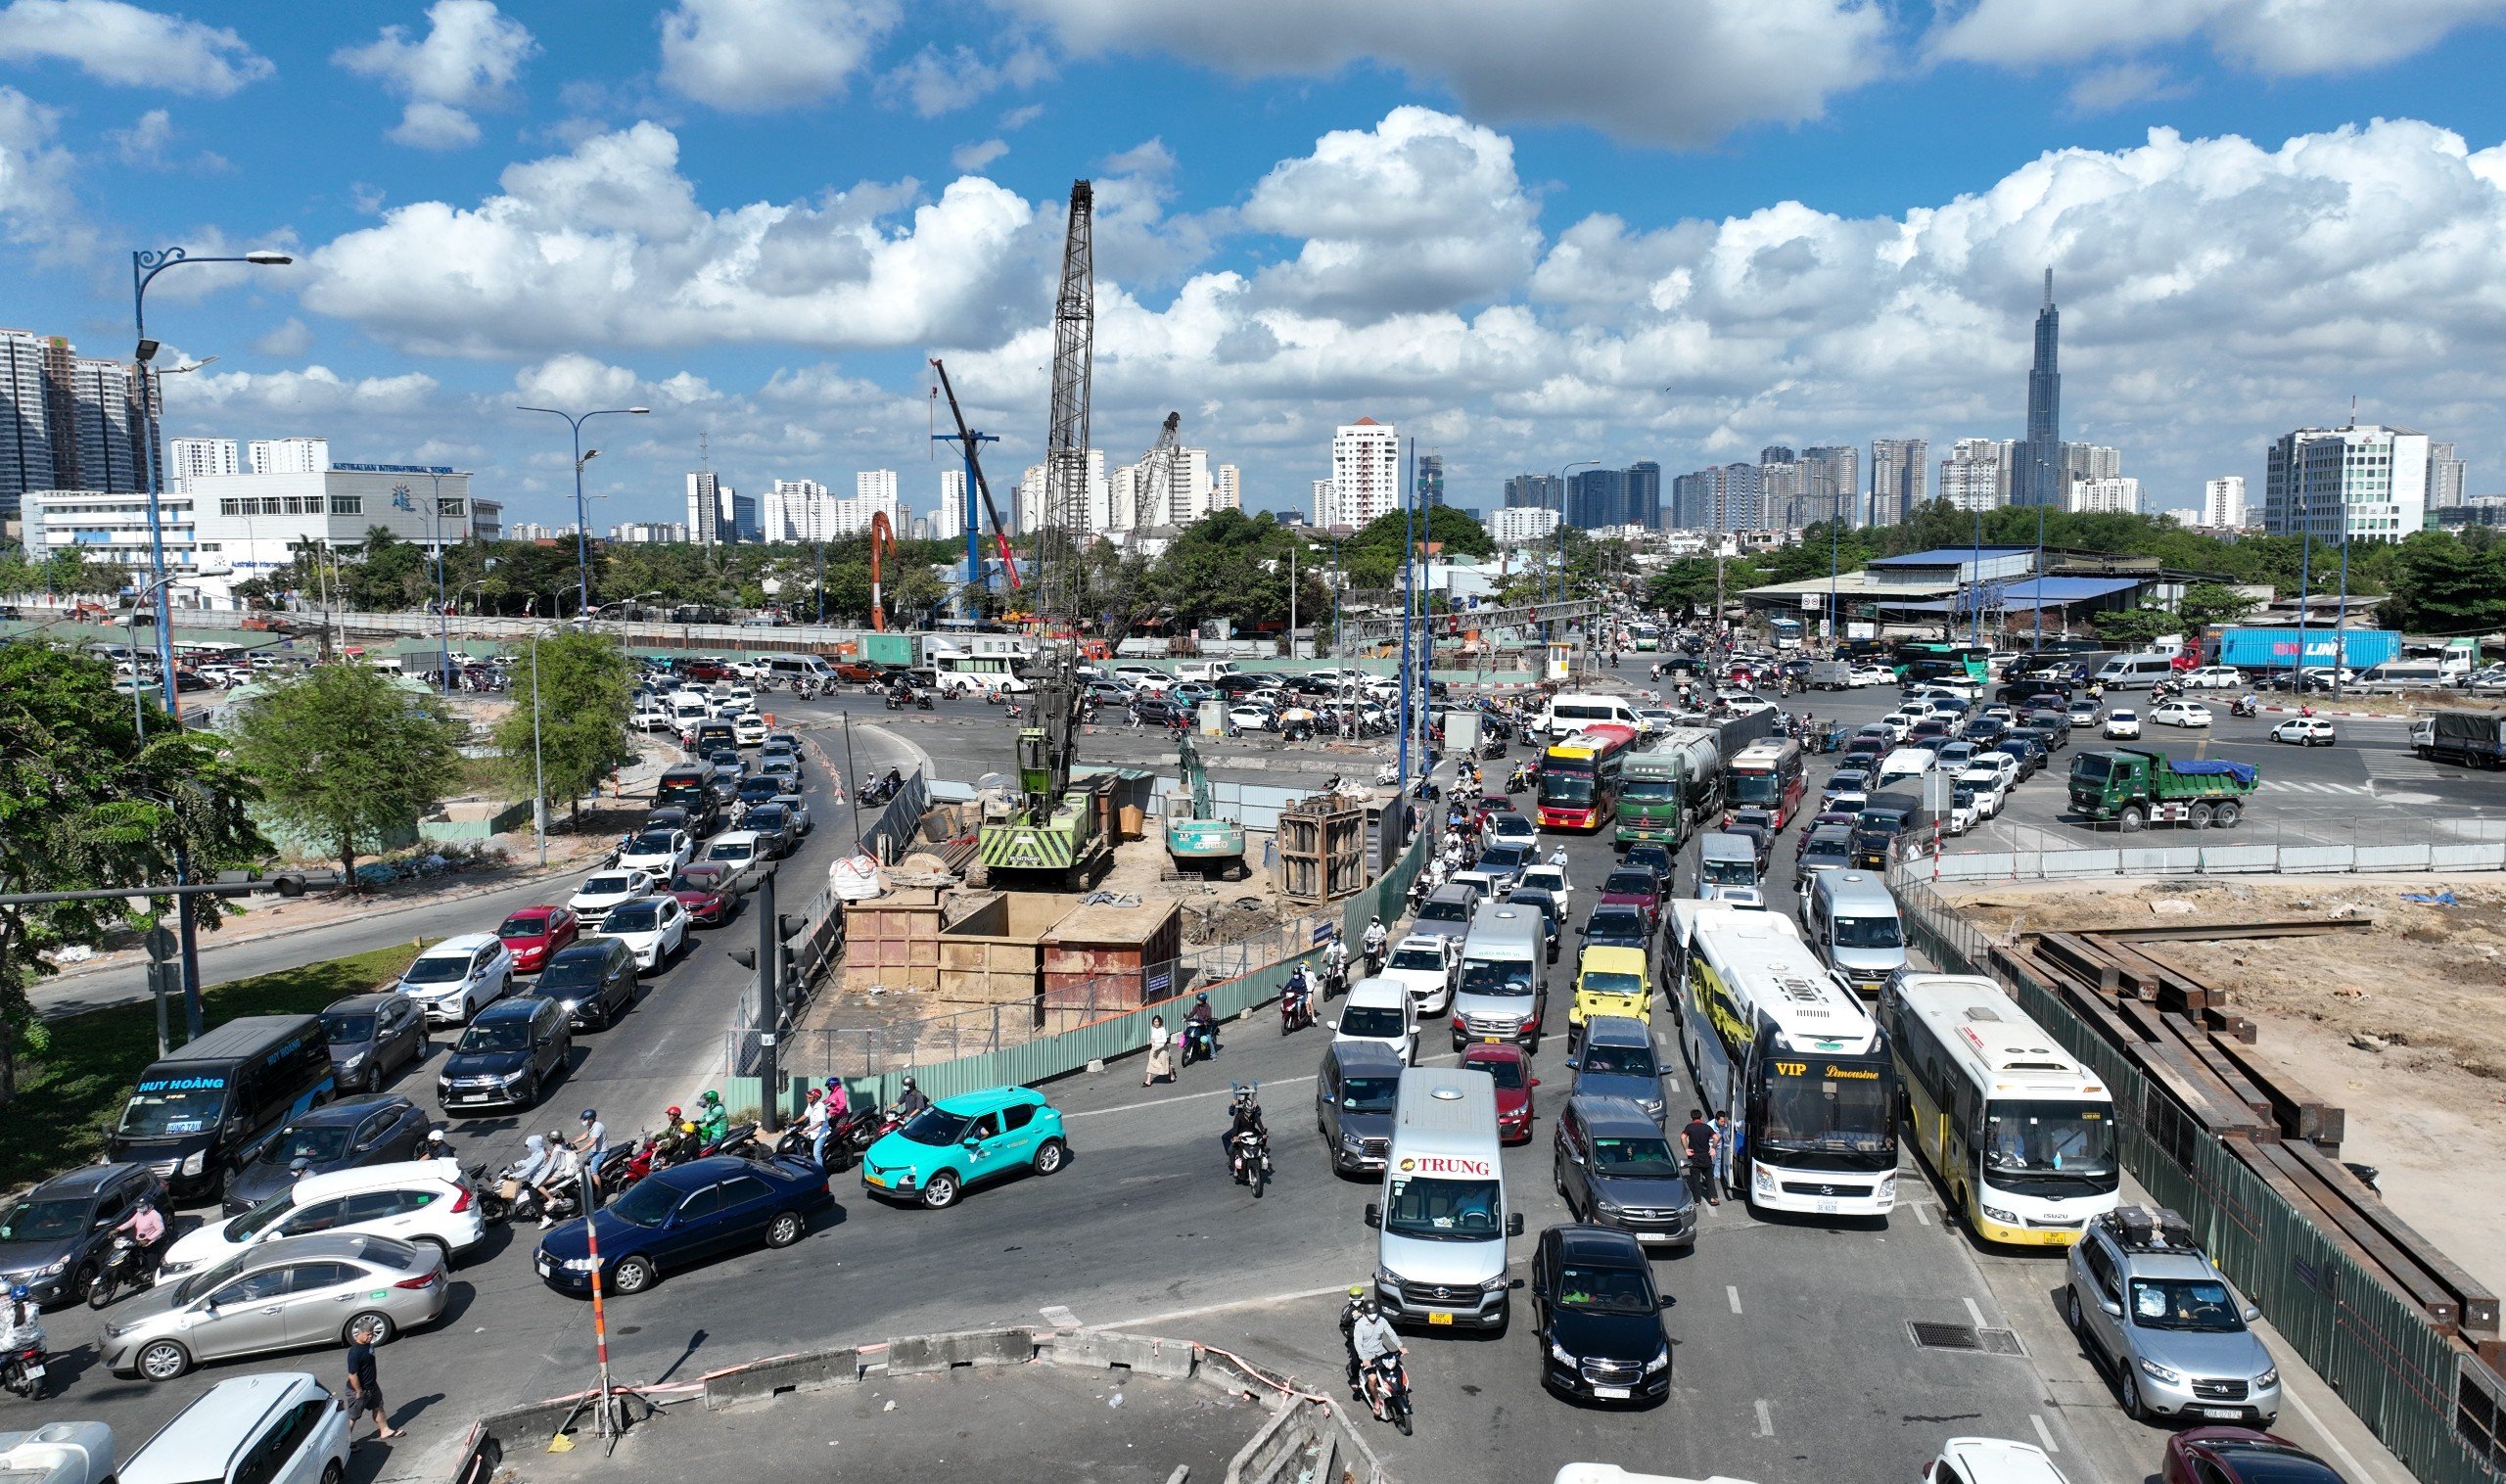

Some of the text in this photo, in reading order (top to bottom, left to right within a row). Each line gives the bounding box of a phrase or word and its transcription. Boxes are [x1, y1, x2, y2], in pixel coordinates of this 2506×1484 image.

[379, 464, 427, 473] INTERNATIONAL
[1776, 1062, 1880, 1080] VIP Limousine
[138, 1080, 169, 1091] HUY
[1418, 1158, 1490, 1177] TRUNG
